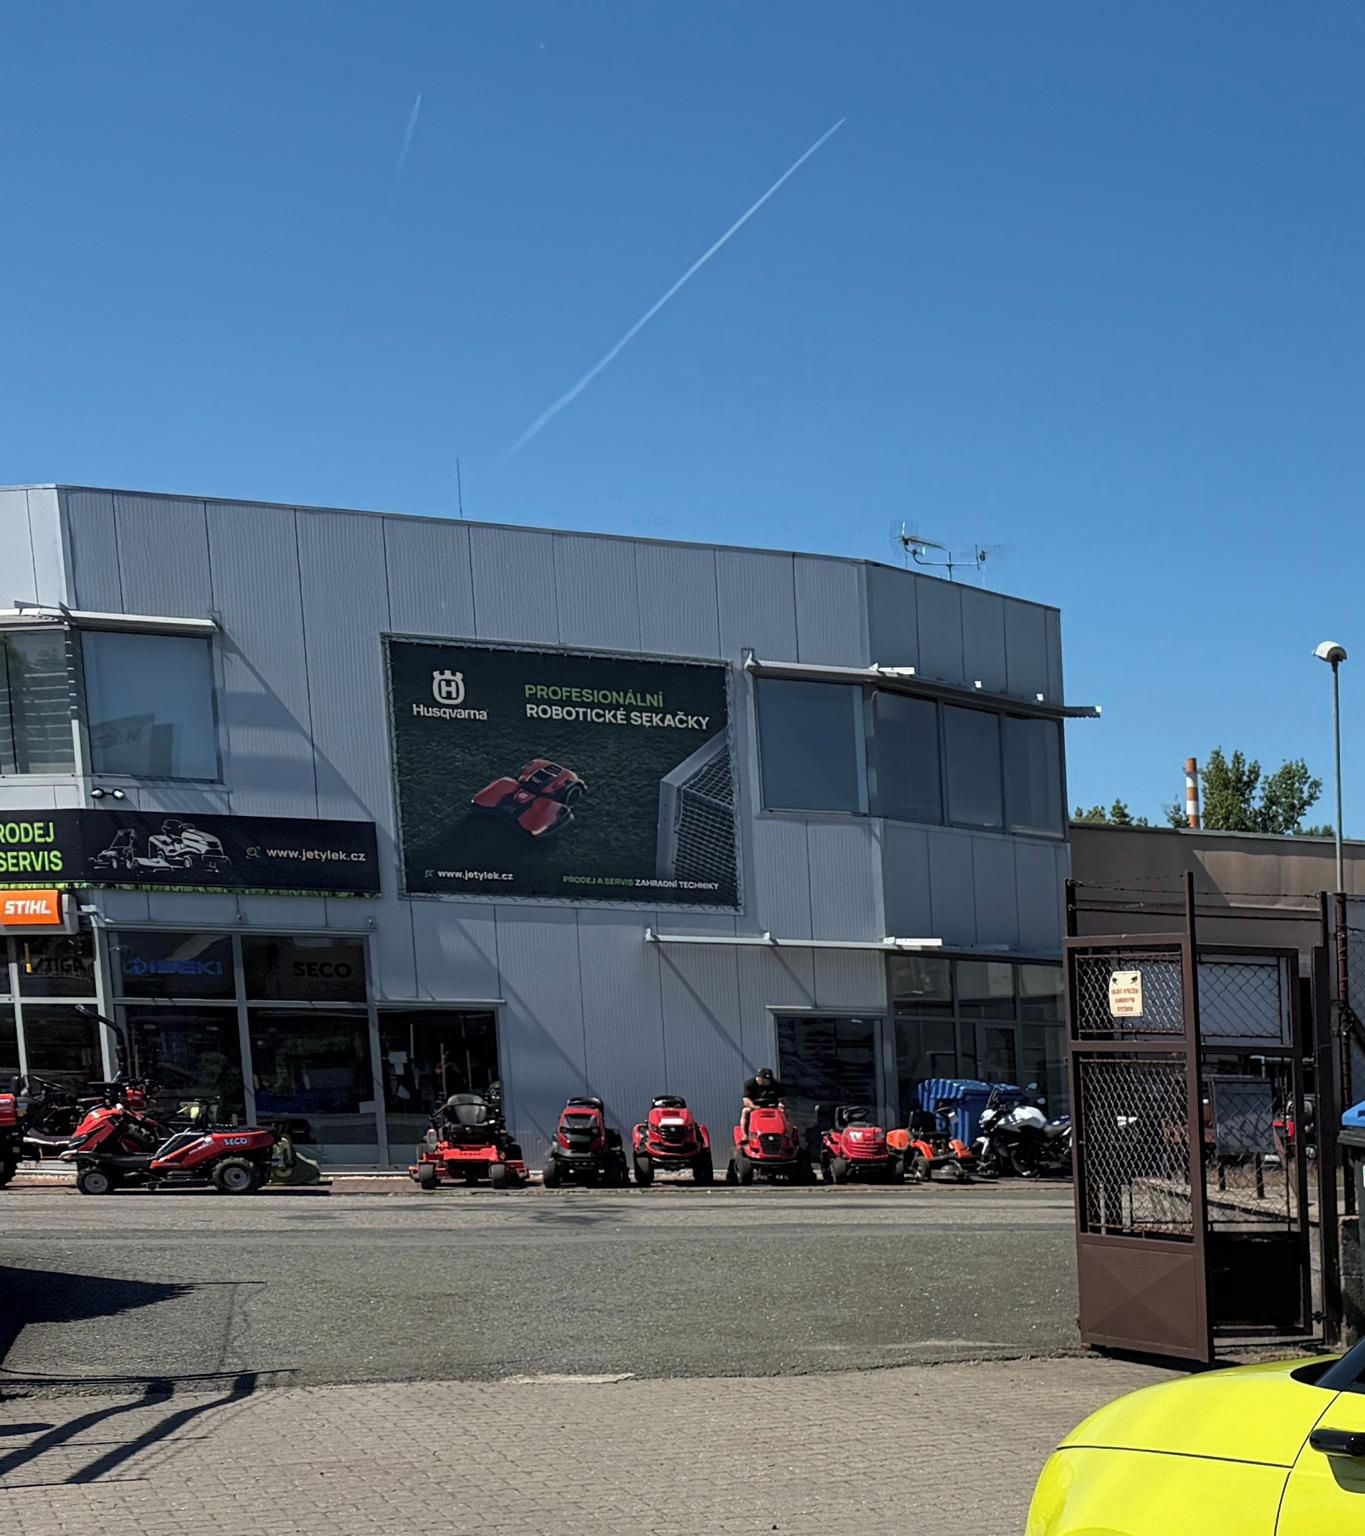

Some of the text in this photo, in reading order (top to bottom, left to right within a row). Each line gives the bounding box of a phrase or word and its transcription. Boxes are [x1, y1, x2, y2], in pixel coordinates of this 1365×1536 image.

[524, 684, 664, 708] PROFESIONÁLNÍ
[412, 703, 488, 720] Husqvarna
[526, 703, 710, 730] ROBOTICKÉ SEKAČKY
[267, 847, 367, 863] www.jetylek.cz
[437, 869, 514, 882] www.jetylek.cz
[4, 899, 52, 914] STIHL
[293, 962, 352, 978] SECO
